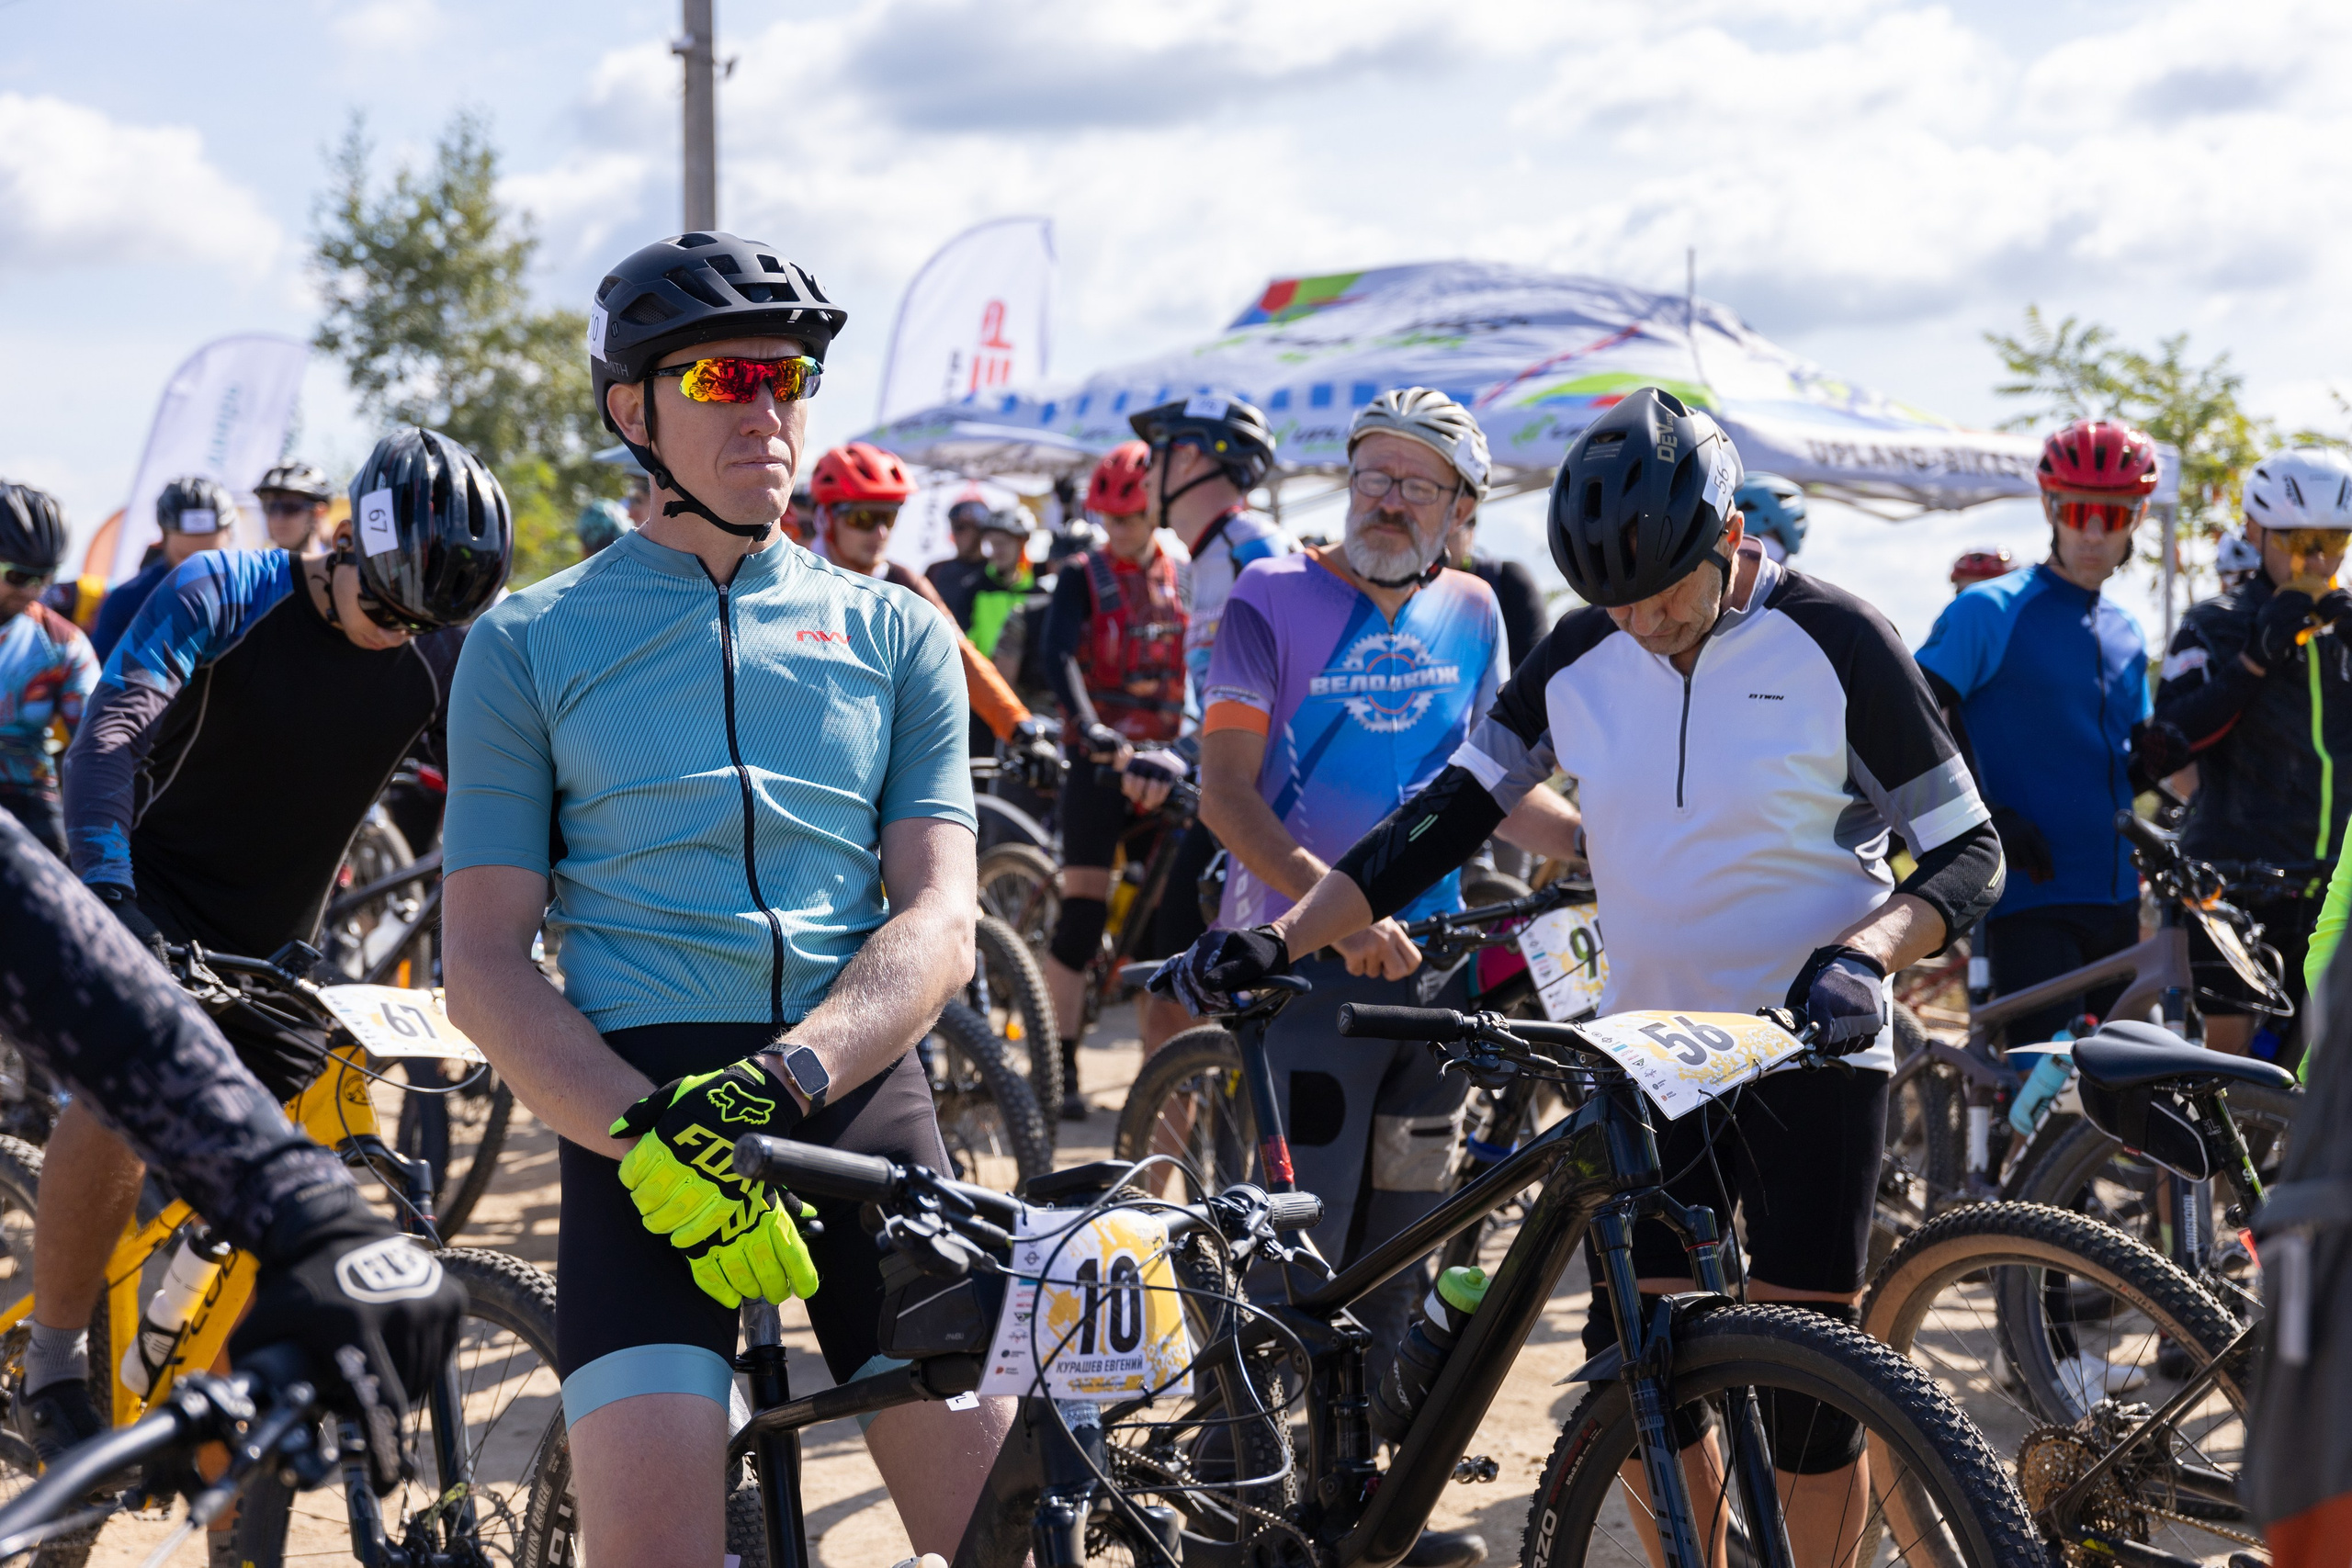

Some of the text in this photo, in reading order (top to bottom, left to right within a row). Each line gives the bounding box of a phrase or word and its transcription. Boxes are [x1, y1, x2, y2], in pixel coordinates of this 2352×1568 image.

[1713, 465, 1730, 494] 56
[368, 508, 389, 534] 67
[379, 1002, 437, 1038] 67
[1637, 1015, 1735, 1066] 56
[1076, 1255, 1147, 1356] 10
[1056, 1355, 1144, 1374] КУРАШЕВ ЕВГЕНИЙ
